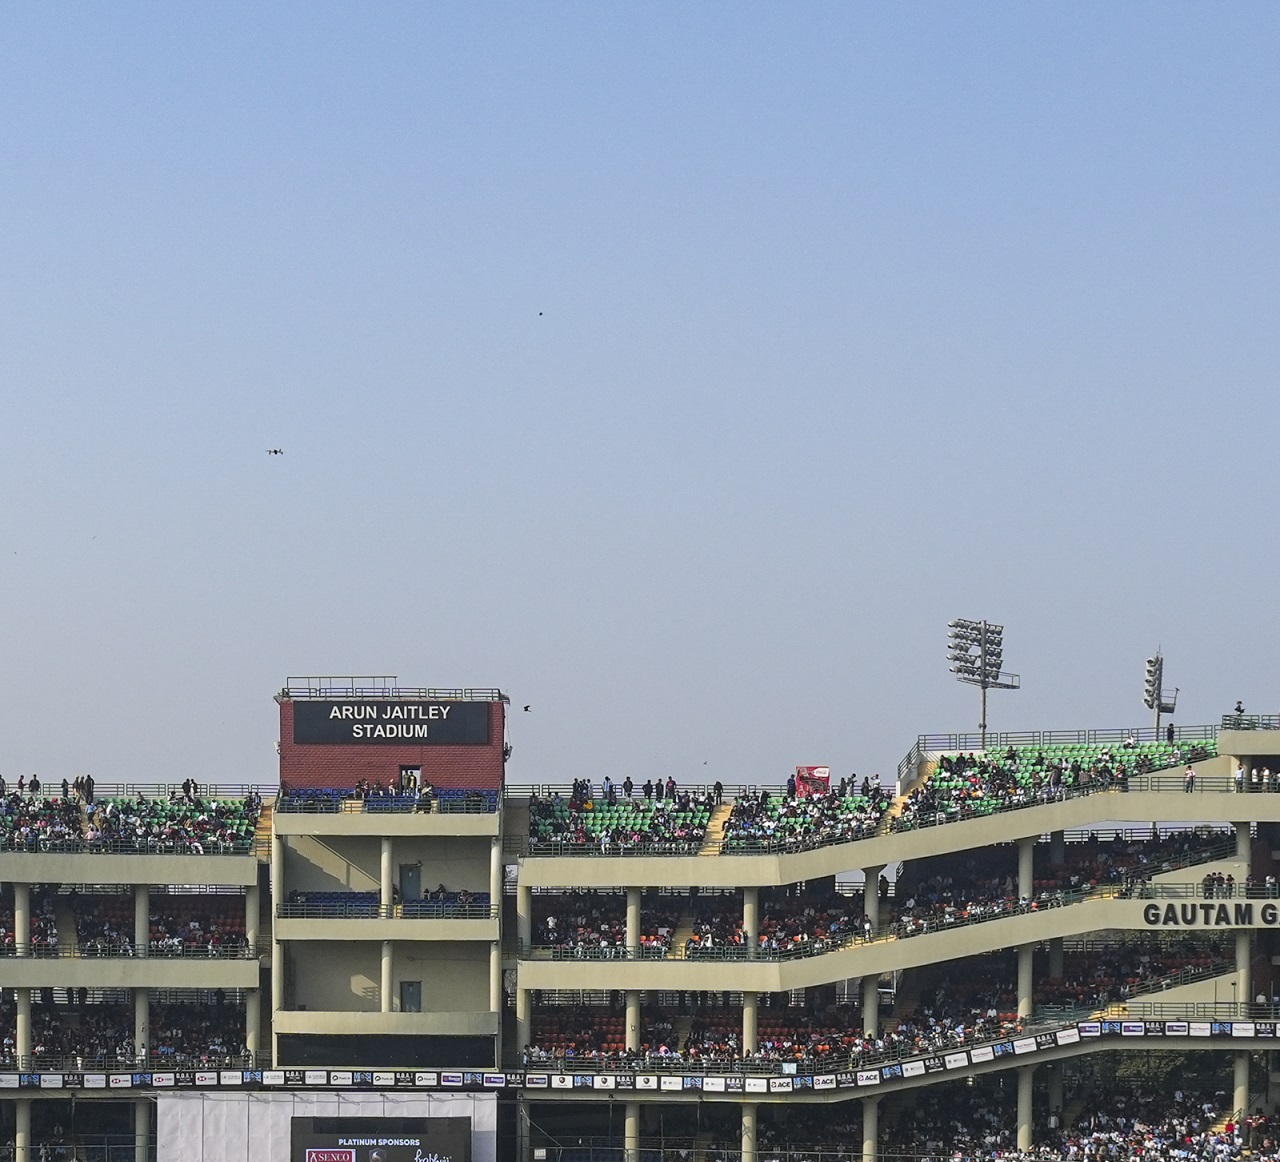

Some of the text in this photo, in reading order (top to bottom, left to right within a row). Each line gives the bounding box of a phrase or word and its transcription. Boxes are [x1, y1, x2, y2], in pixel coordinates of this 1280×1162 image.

[329, 706, 451, 719] ARUN JAITLEY
[352, 724, 428, 738] STADIUM
[1144, 902, 1253, 925] GAUTAM
[318, 1153, 350, 1162] SENCO
